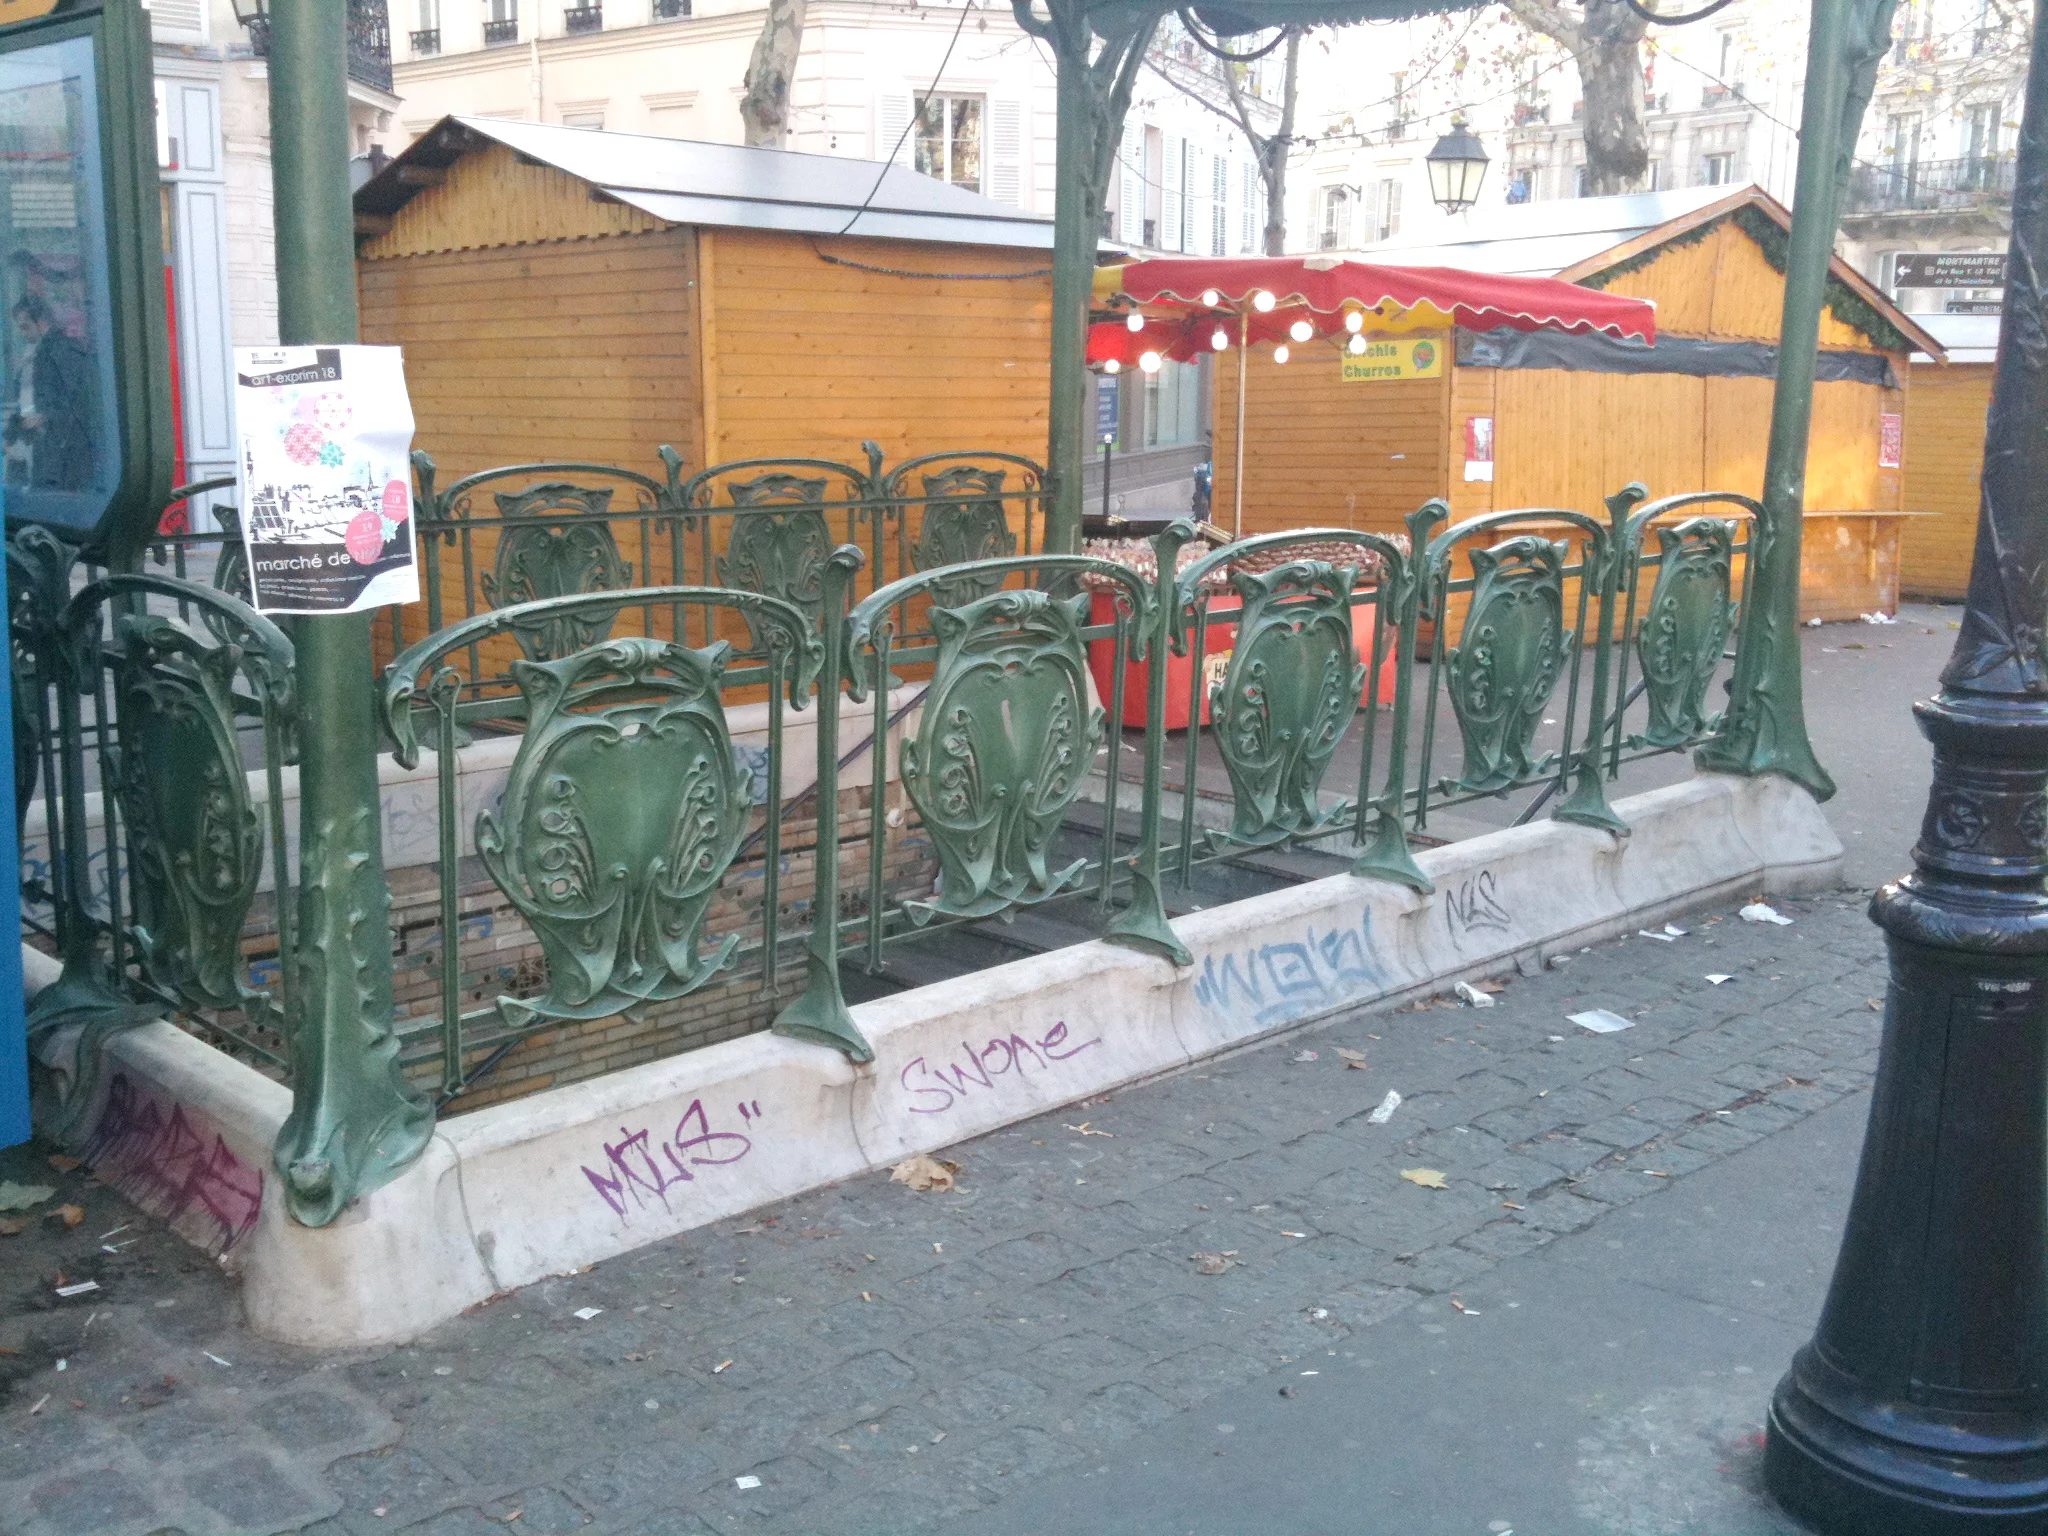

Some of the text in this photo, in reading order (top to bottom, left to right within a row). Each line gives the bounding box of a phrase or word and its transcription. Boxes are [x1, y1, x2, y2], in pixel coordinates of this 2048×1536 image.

[1937, 257, 2000, 266] MONTMARTRE
[251, 366, 337, 386] art-exprim 18
[1344, 364, 1402, 378] Churros
[256, 553, 323, 572] marché
[327, 552, 351, 566] de
